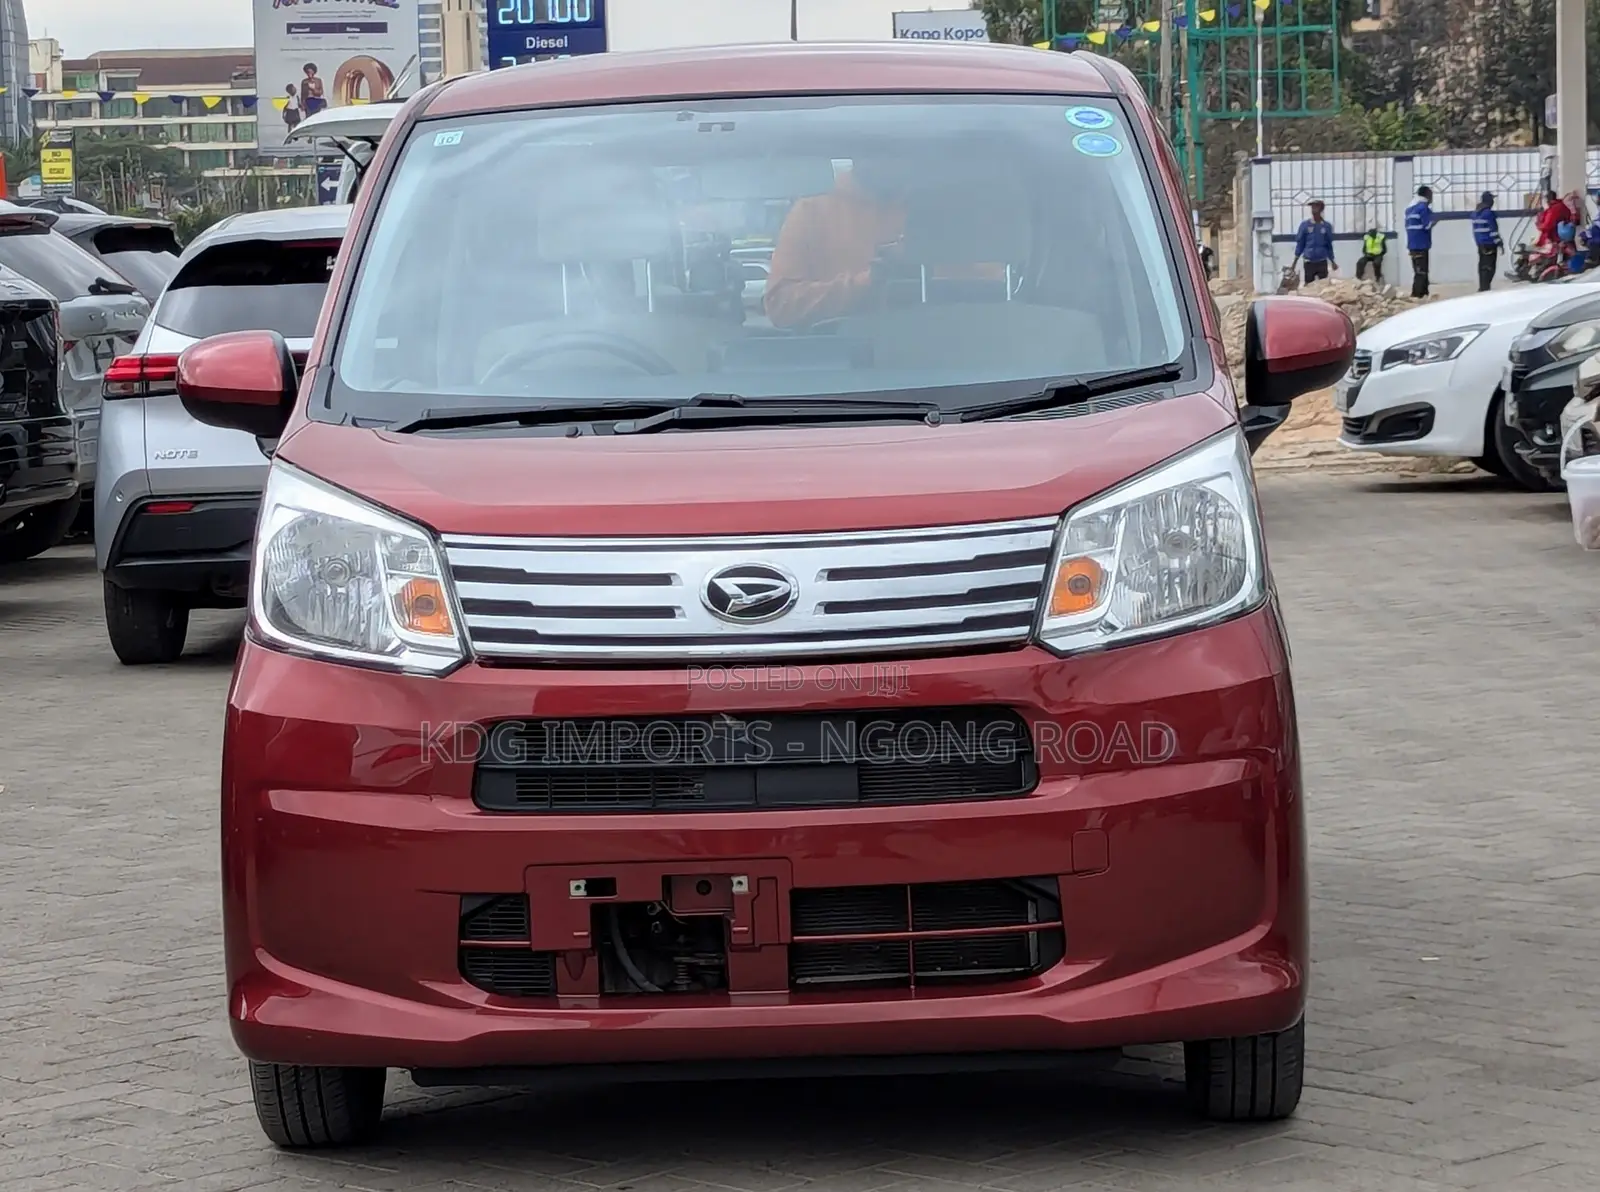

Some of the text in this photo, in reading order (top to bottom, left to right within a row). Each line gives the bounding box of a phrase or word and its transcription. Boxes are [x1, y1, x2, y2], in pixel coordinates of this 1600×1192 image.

[944, 27, 986, 41] Kopo
[526, 35, 568, 48] Diesel
[154, 449, 200, 460] NOTE
